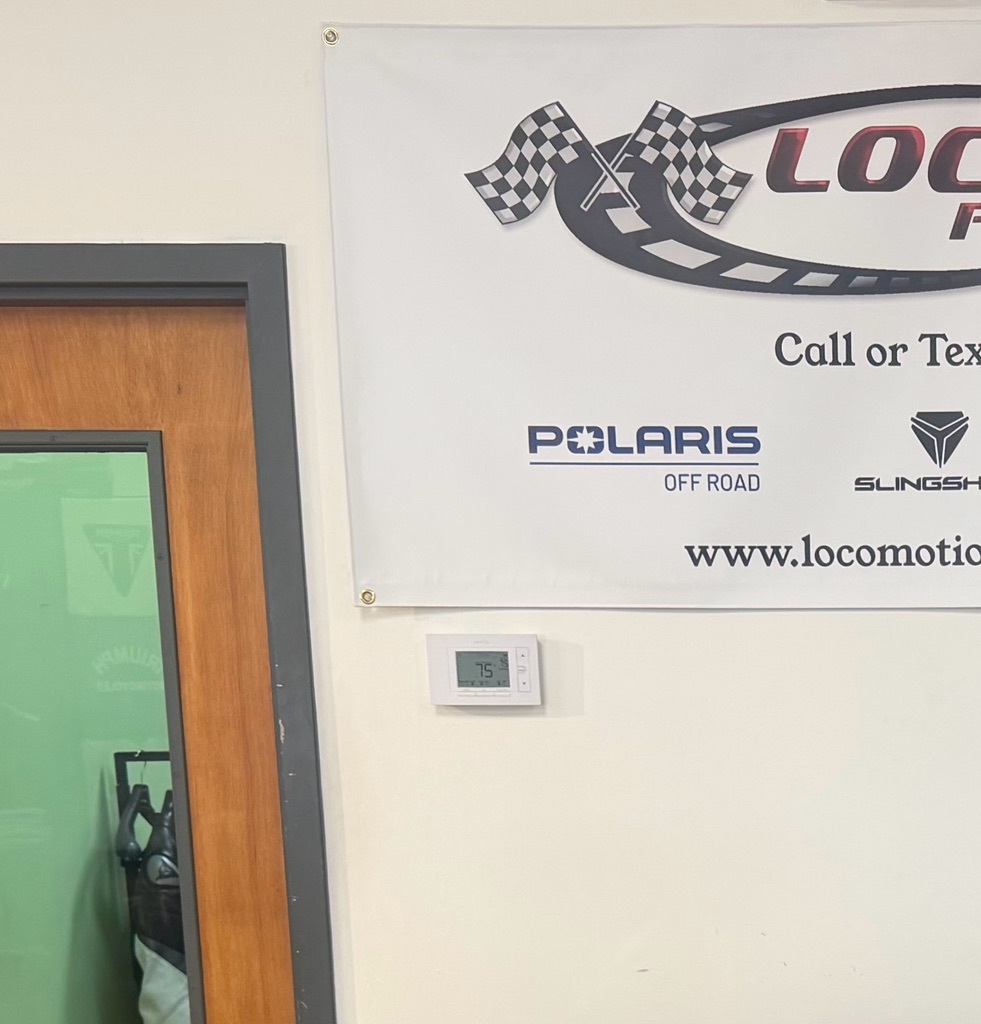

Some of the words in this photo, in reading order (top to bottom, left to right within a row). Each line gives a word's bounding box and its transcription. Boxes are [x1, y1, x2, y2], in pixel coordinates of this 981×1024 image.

[775, 332, 855, 366] Call
[867, 344, 908, 366] or
[528, 426, 760, 454] POLARIS
[664, 474, 701, 492] OFF
[708, 474, 760, 492] ROAD
